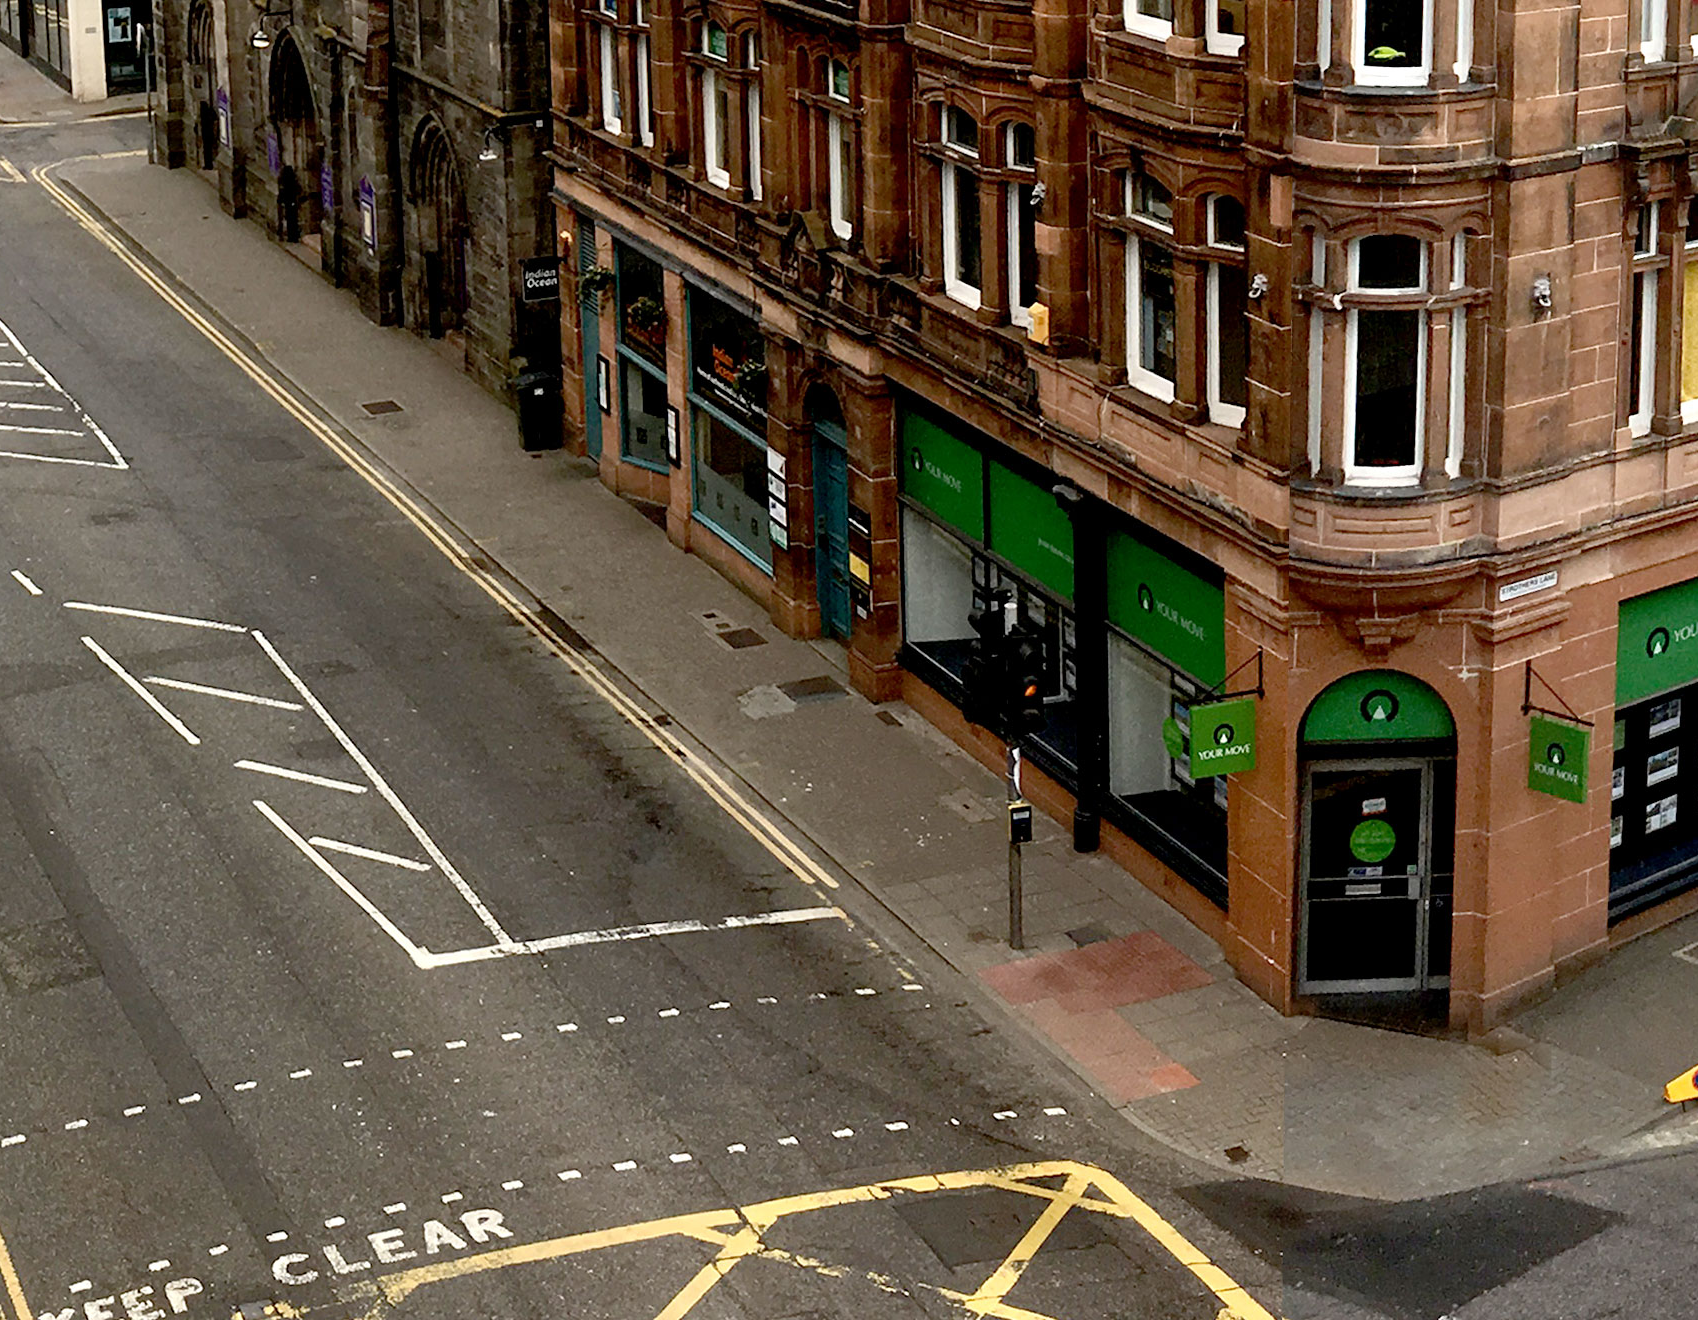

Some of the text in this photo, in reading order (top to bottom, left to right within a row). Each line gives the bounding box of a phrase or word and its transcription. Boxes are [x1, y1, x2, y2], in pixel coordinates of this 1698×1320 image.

[525, 269, 556, 280] Indian
[527, 278, 558, 288] Ocean
[1156, 600, 1205, 641] YOUR MOVE
[1199, 743, 1250, 761] YOUR MOVE
[1534, 763, 1578, 784] YOUR MOVE
[272, 1207, 515, 1286] CLEAR
